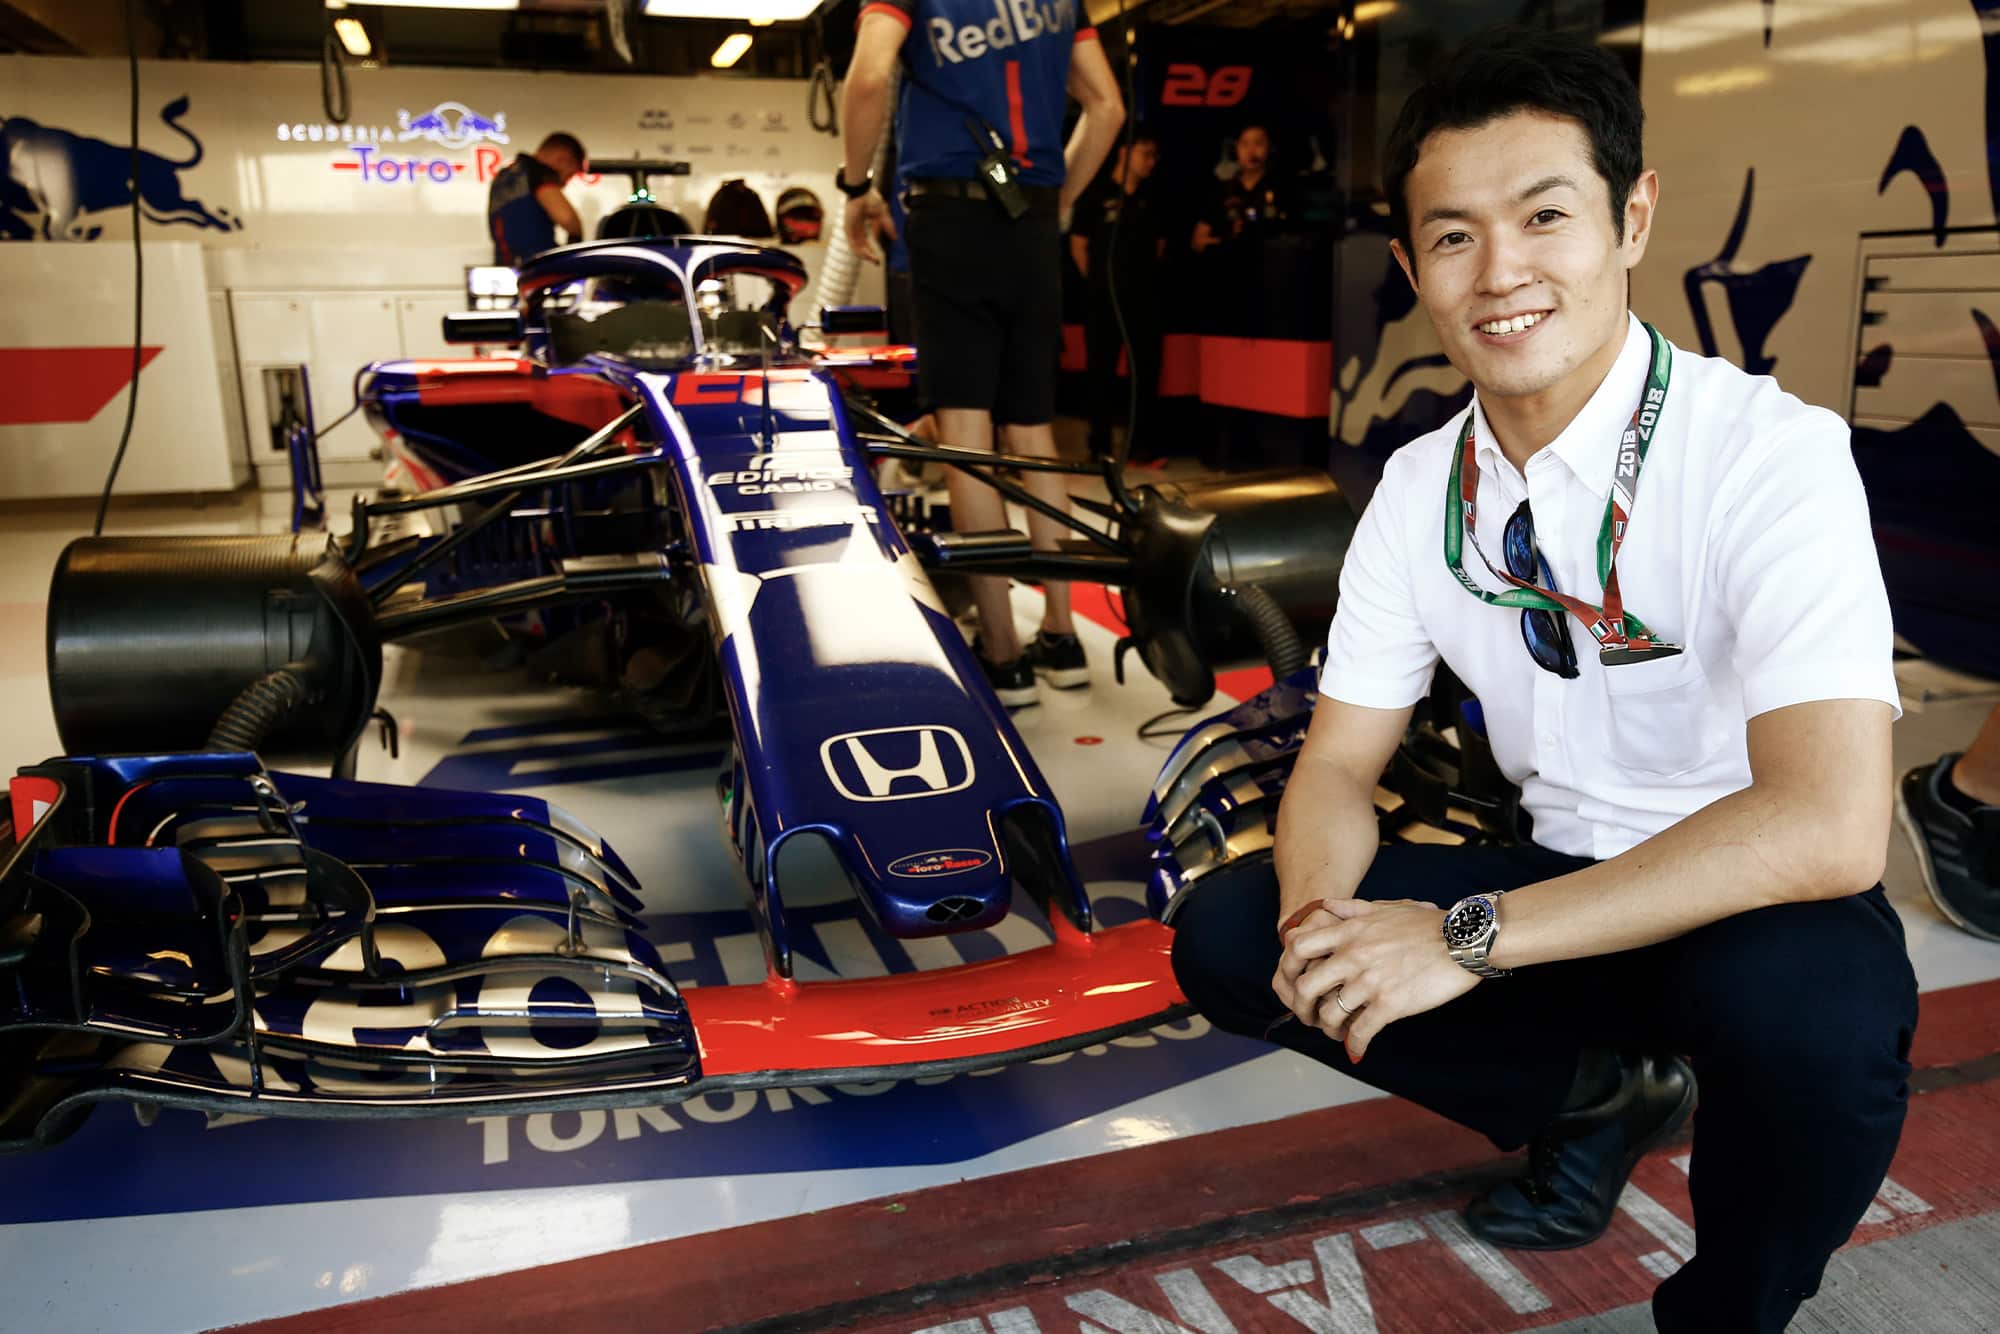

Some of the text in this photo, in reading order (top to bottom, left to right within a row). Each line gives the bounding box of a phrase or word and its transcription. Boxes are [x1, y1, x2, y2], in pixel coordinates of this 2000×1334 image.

[1162, 63, 1253, 107] 28
[1638, 387, 1664, 441] 2018
[1617, 429, 1636, 478] 2018
[738, 480, 836, 496] CASIO
